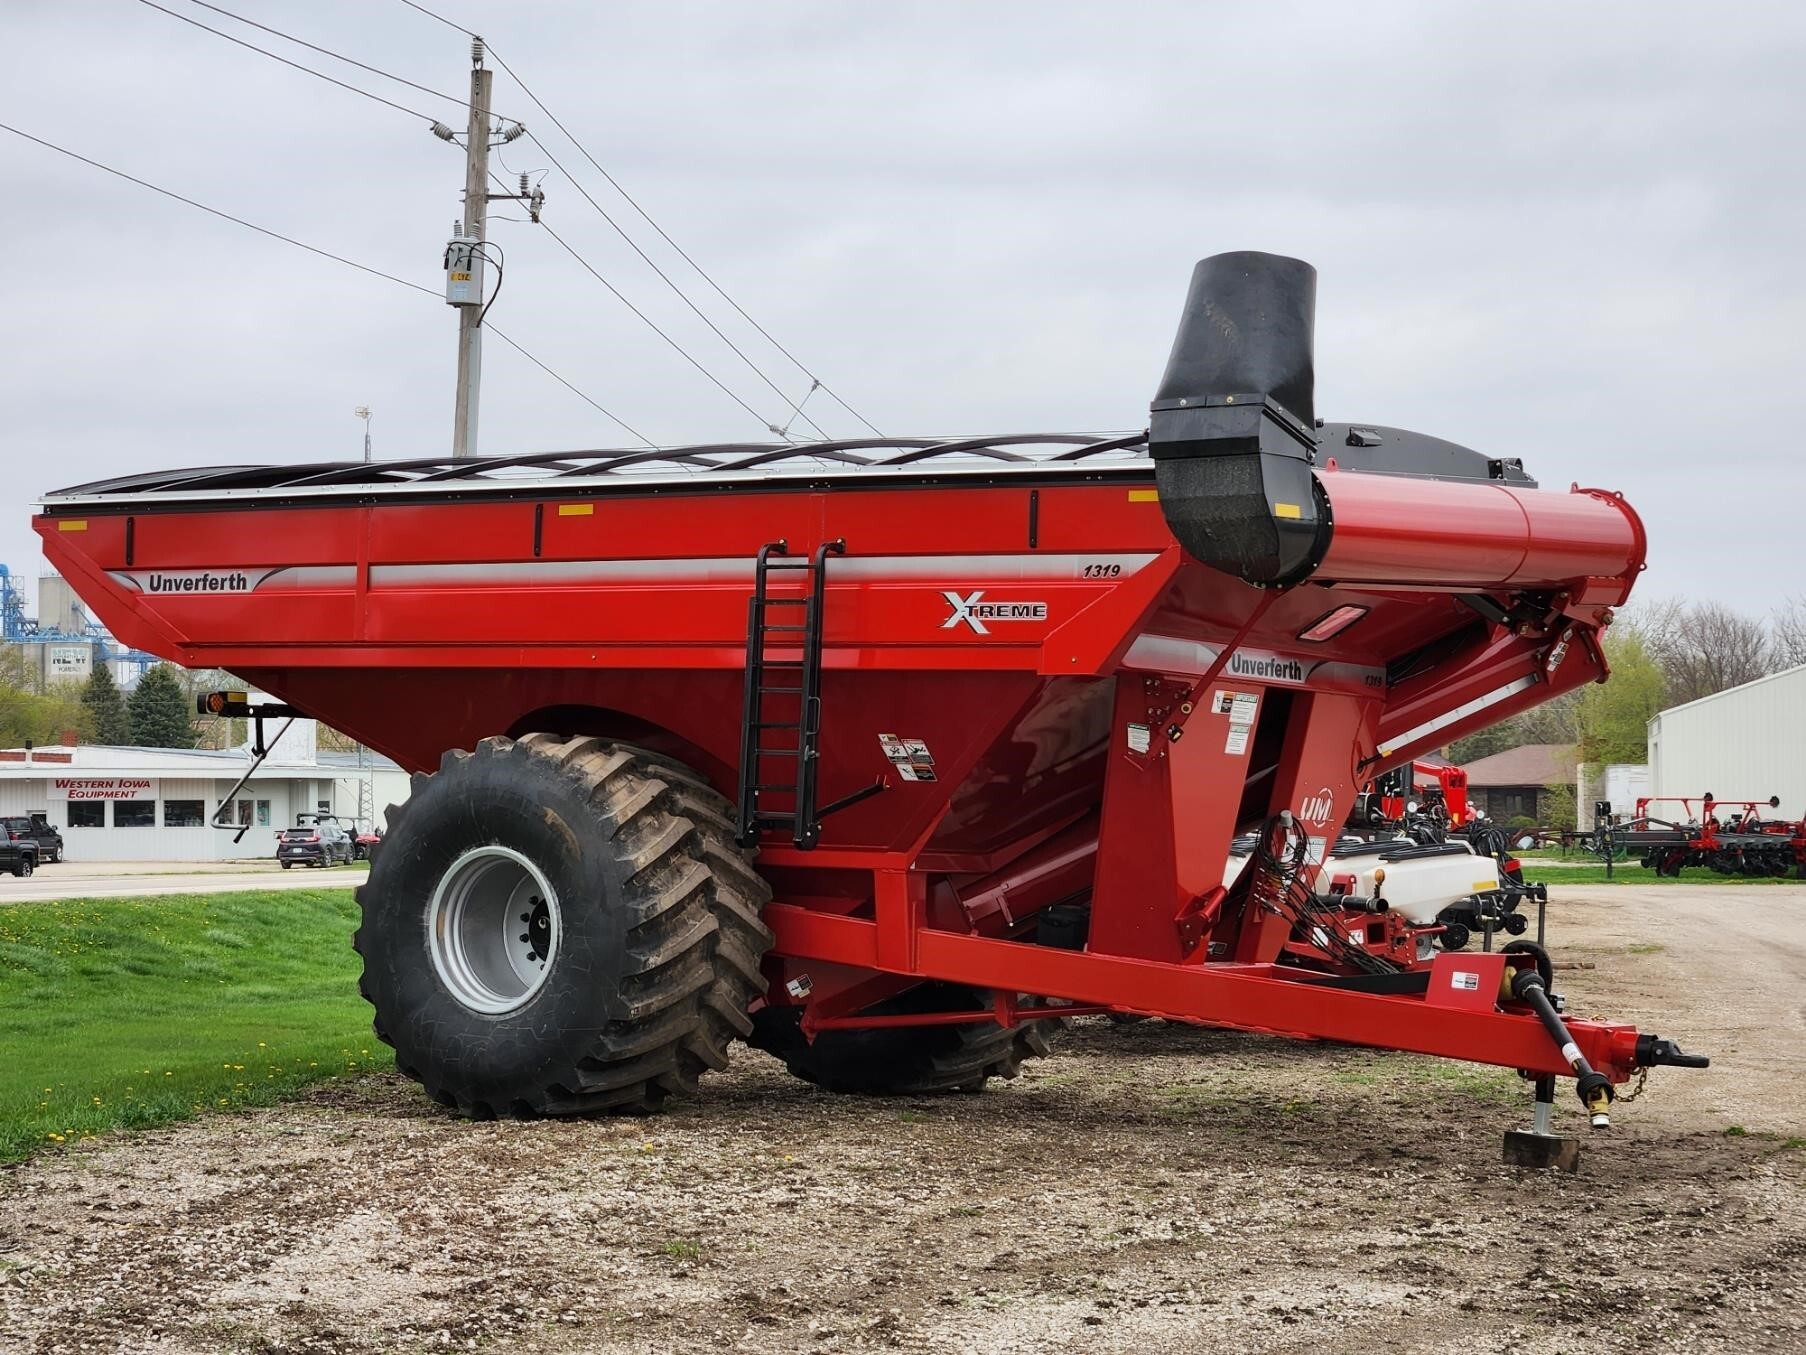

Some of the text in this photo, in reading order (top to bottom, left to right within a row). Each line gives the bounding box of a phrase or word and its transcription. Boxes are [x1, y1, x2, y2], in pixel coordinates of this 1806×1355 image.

[1083, 564, 1121, 578] 1319
[149, 573, 247, 592] Unverferth
[1231, 653, 1302, 681] Unverferth
